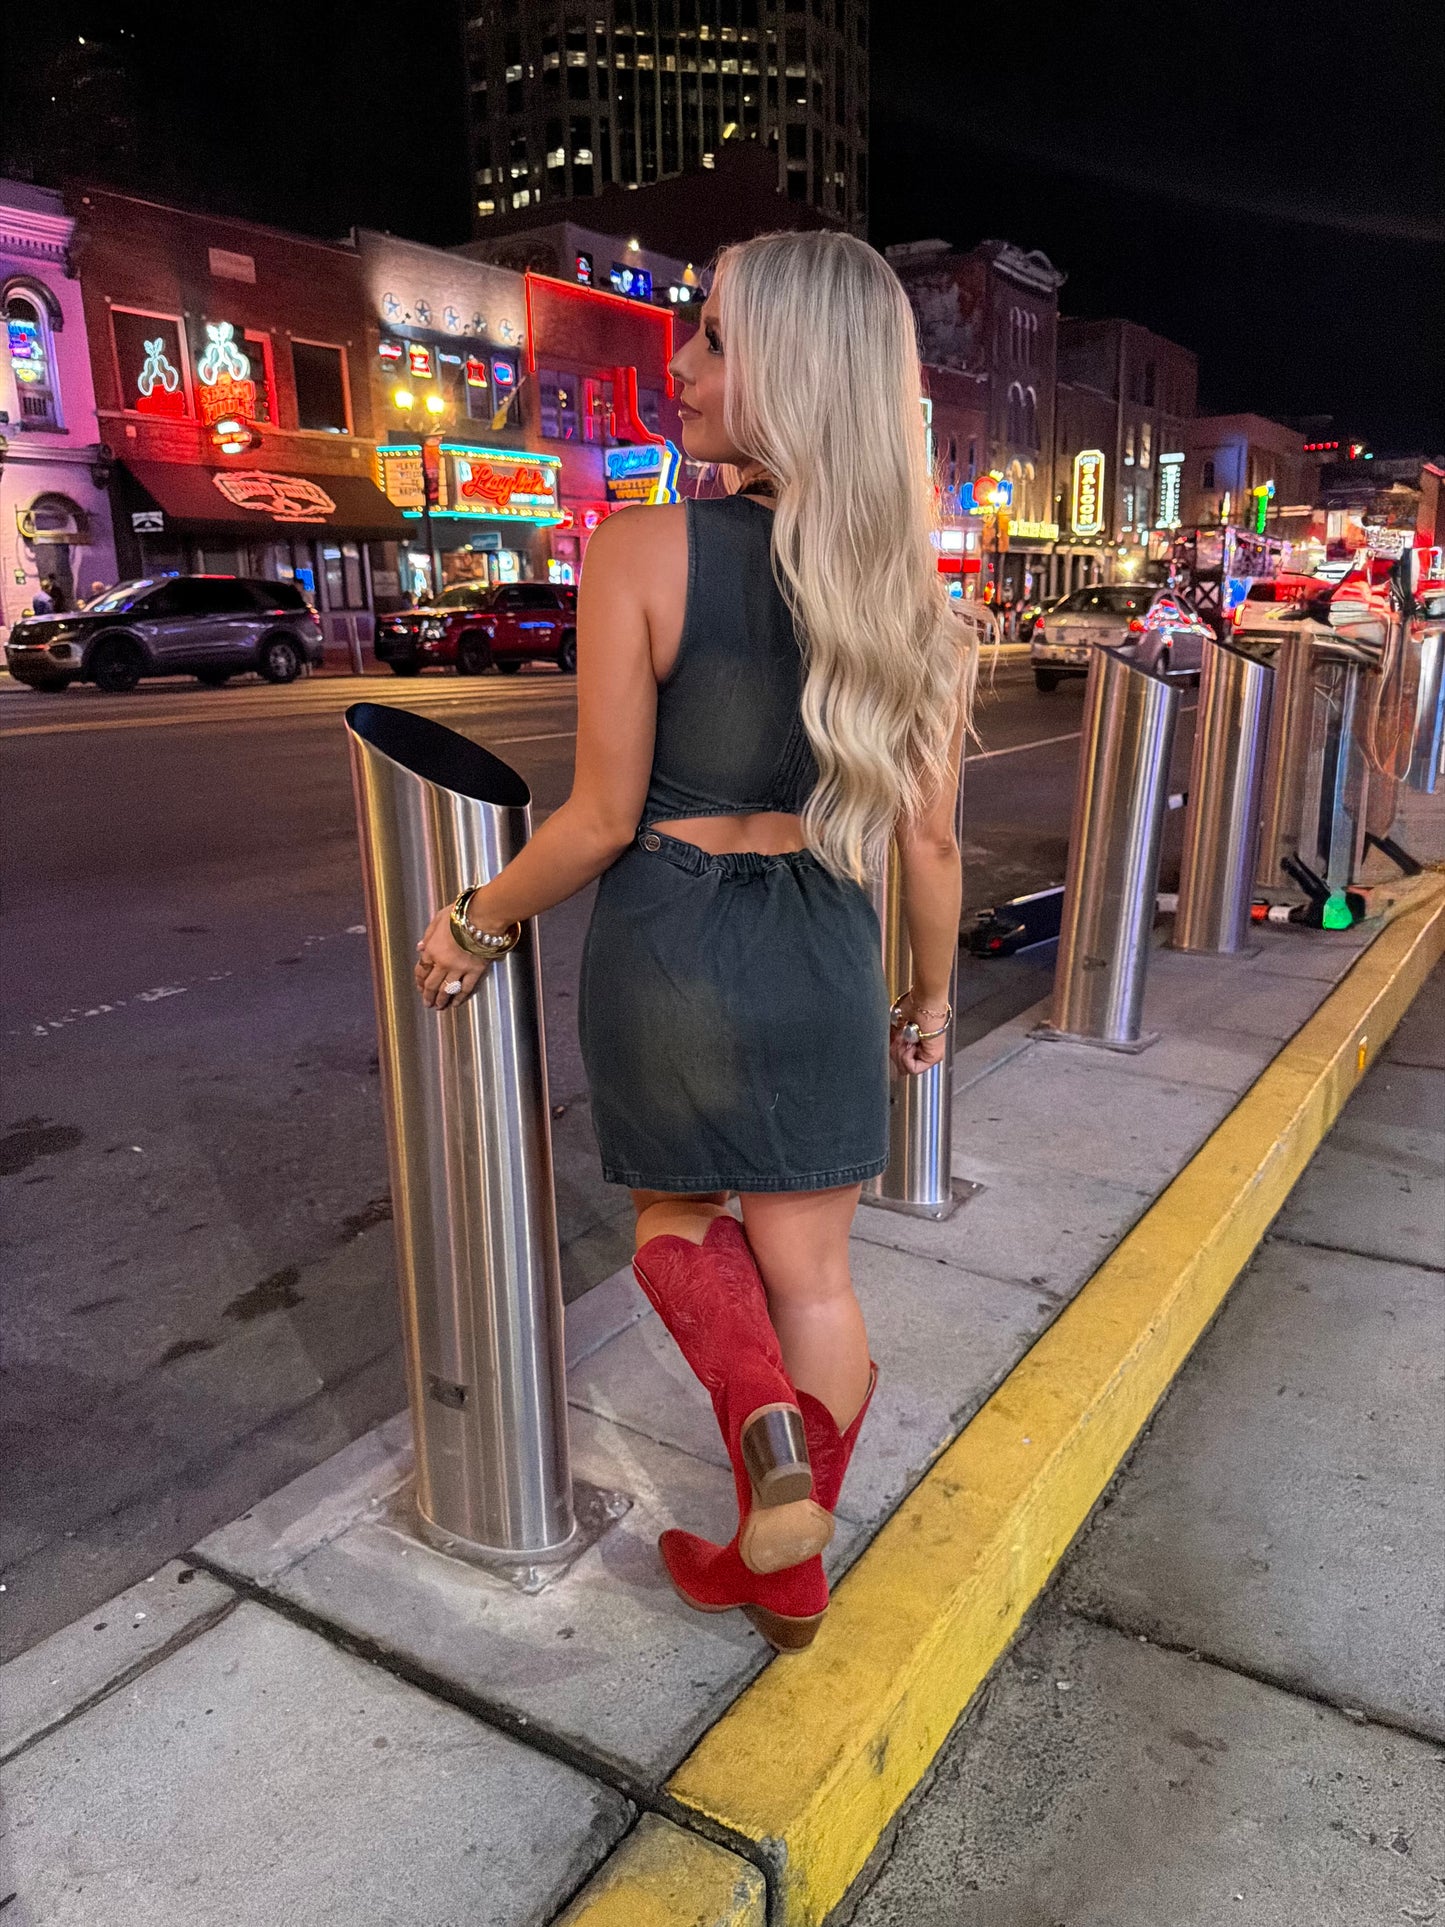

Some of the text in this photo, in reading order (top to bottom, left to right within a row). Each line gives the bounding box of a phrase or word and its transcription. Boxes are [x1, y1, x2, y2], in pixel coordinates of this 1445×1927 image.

[203, 399, 255, 425] FIDDLE
[608, 447, 659, 480] Robert's
[461, 463, 553, 505] Layla's
[1079, 462, 1097, 525] SALOON
